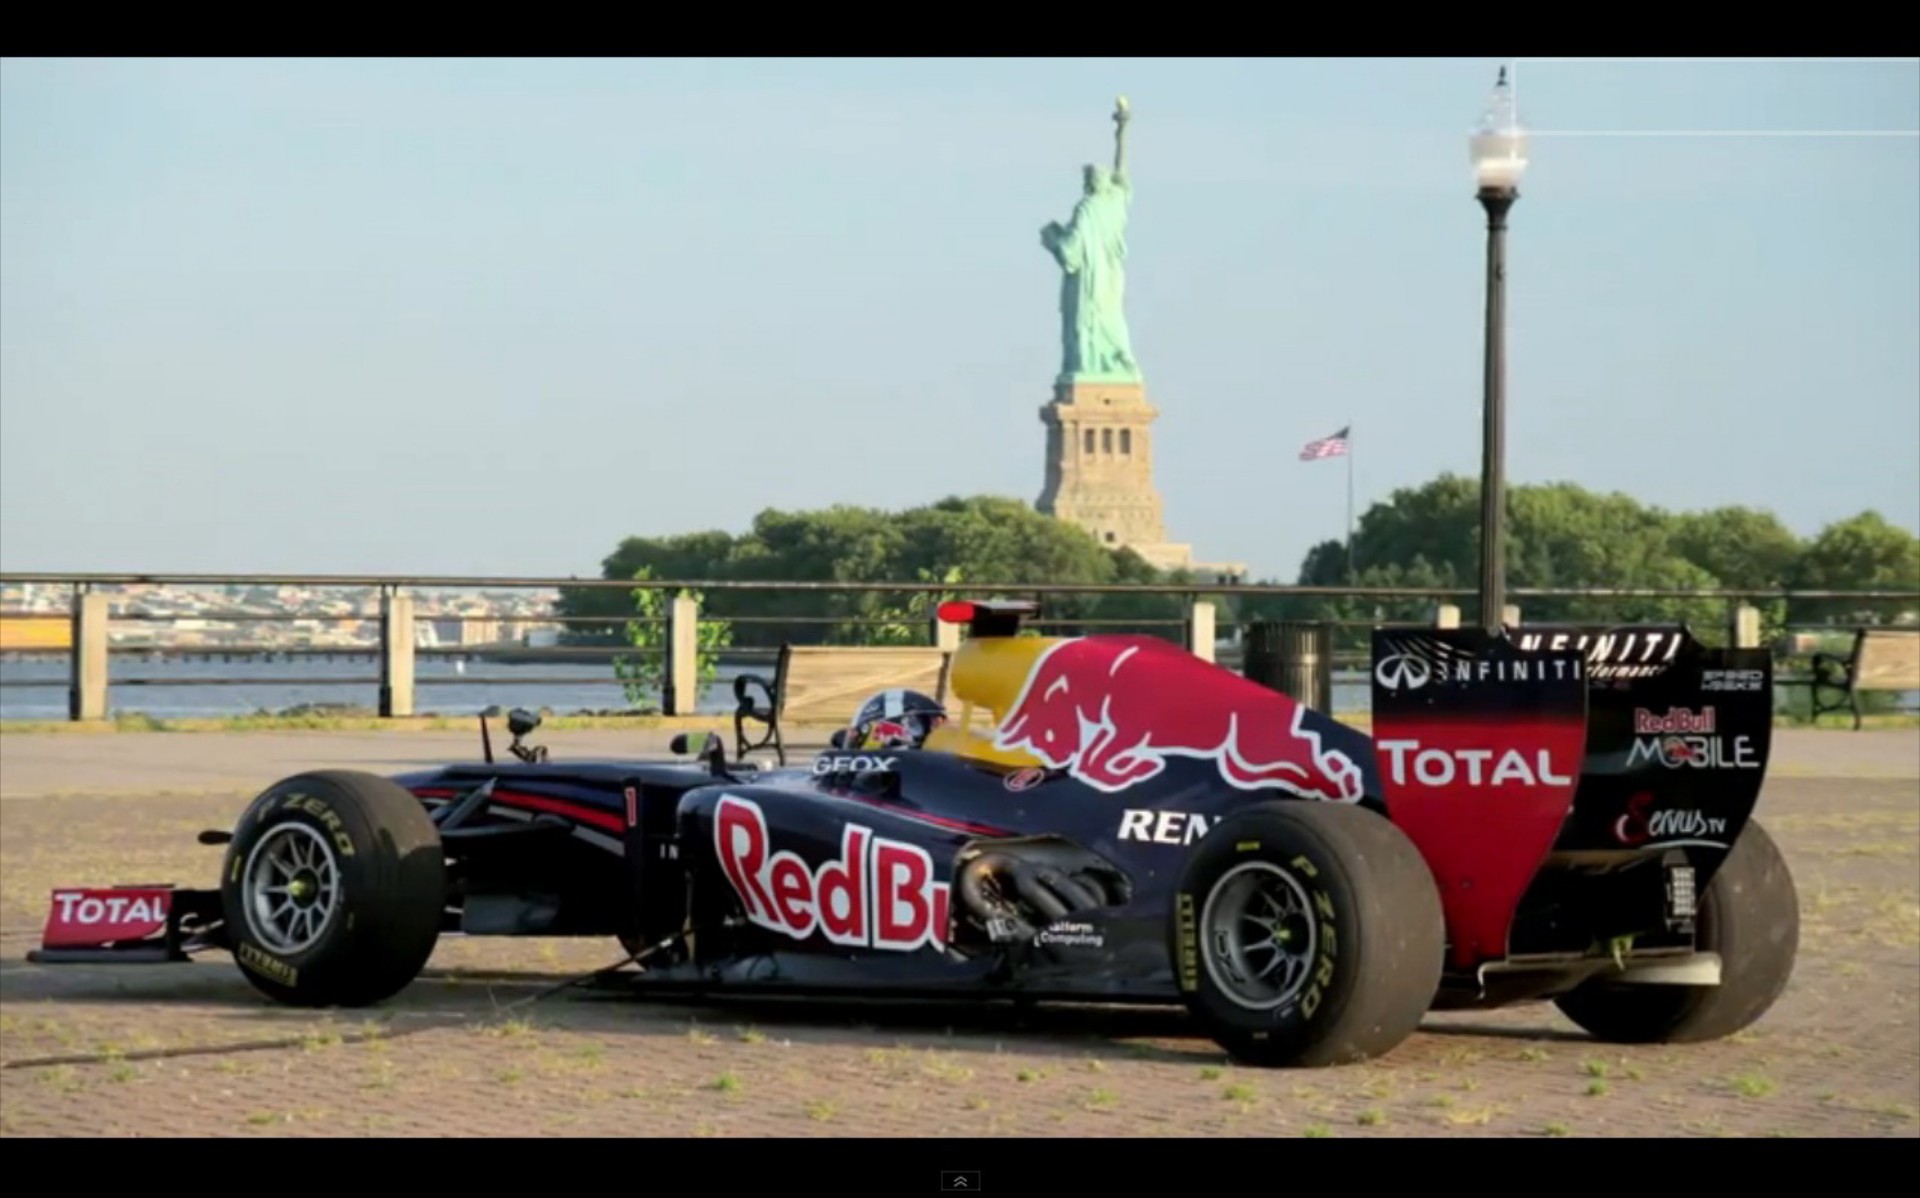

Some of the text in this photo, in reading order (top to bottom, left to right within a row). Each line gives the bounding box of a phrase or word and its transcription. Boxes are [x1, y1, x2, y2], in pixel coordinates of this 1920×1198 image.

[1505, 633, 1683, 662] NFINITI
[1377, 739, 1572, 786] TOTAL
[1626, 736, 1760, 768] MOBILE
[282, 793, 356, 856] ZERO
[54, 892, 168, 924] TOTAL
[1301, 890, 1337, 1020] ZERO
